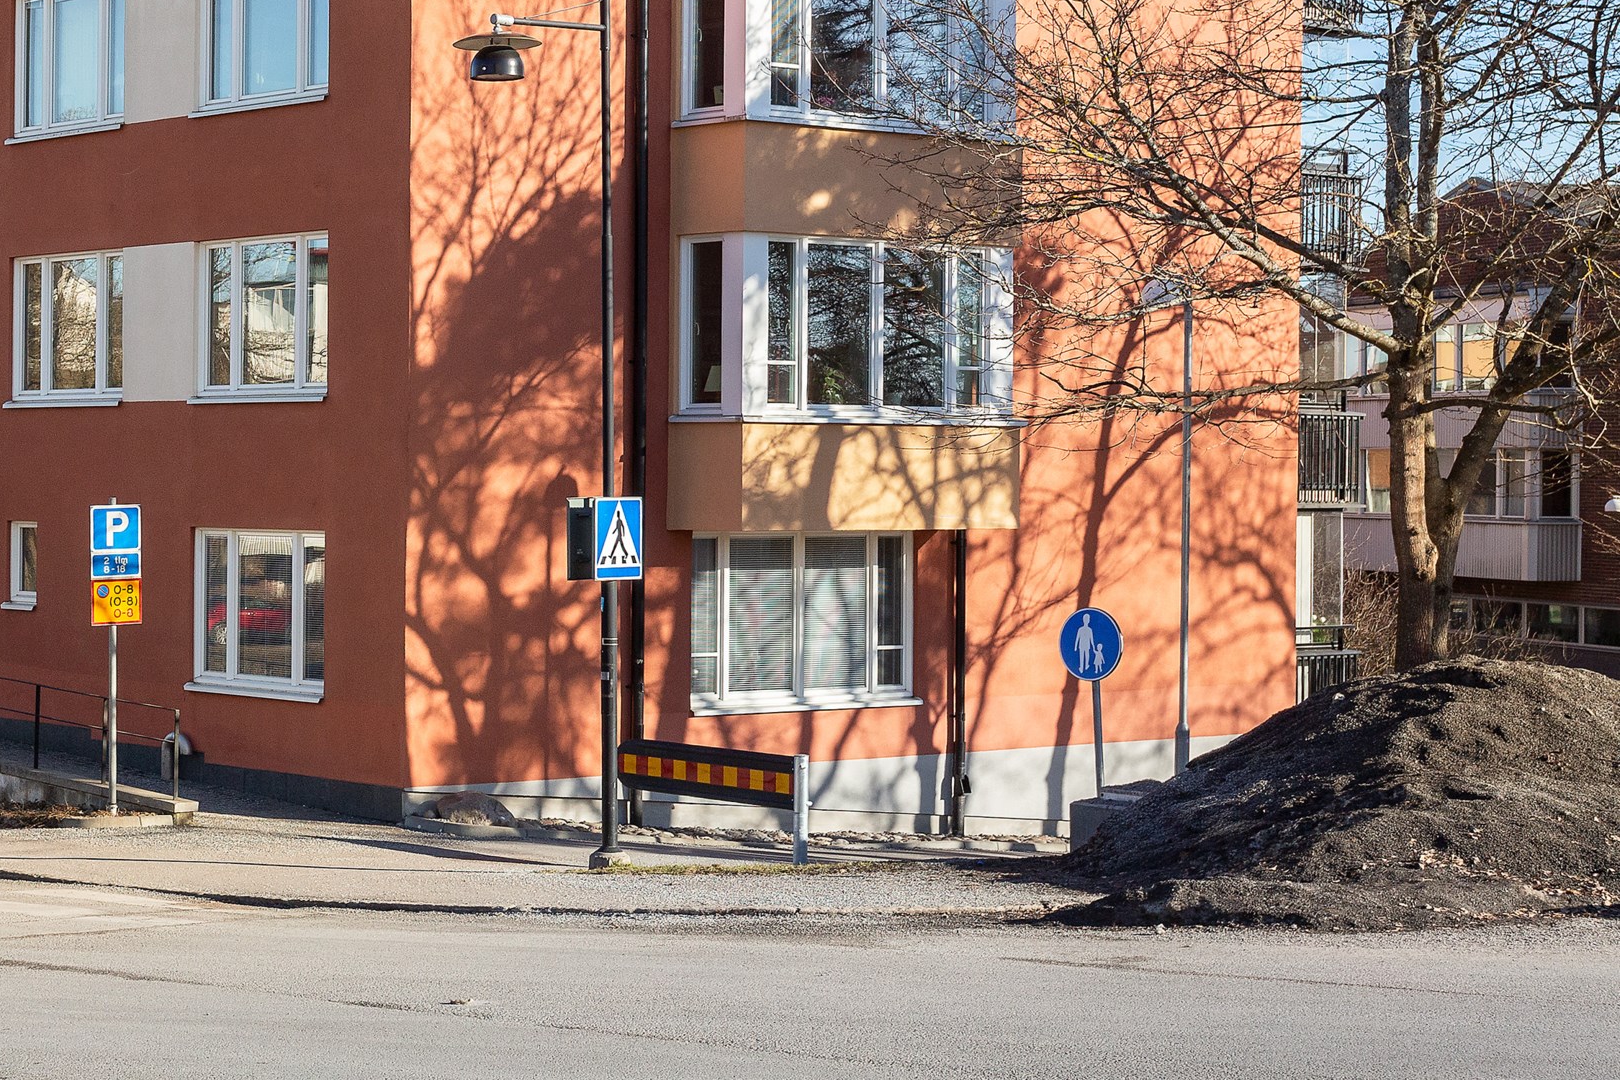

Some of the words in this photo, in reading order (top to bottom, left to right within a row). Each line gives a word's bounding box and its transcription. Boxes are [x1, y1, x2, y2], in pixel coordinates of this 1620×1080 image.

[106, 511, 129, 547] P
[103, 557, 110, 565] 2
[113, 584, 134, 595] 0-8
[109, 595, 138, 607] (0-8)
